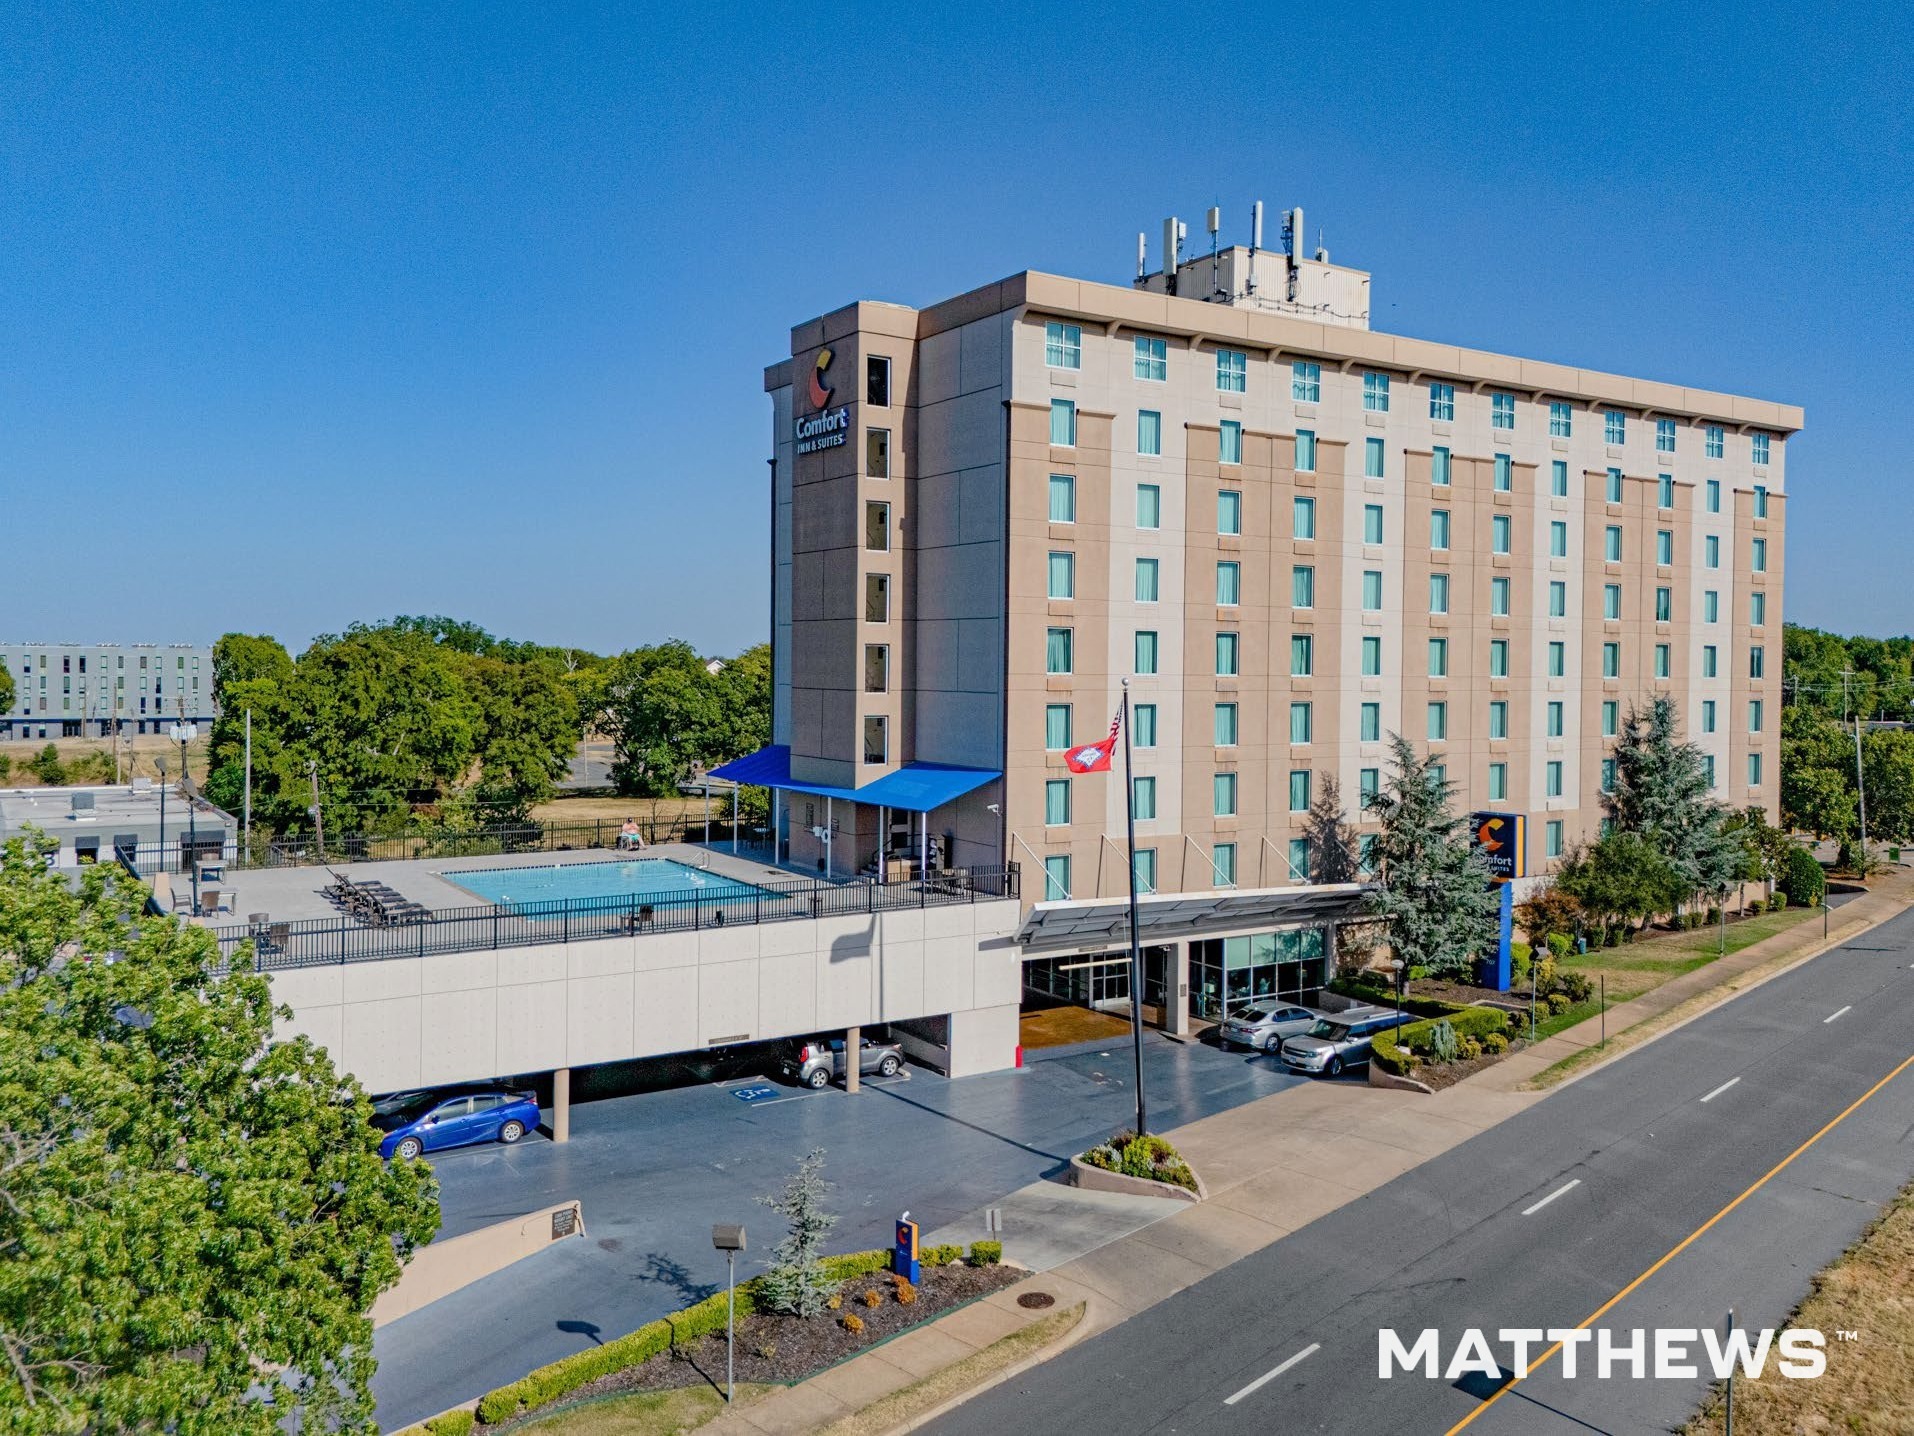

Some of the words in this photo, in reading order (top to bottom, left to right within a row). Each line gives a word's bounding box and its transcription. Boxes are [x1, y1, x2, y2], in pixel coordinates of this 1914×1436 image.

[796, 408, 846, 439] Comfort
[797, 442, 811, 454] INN
[811, 440, 817, 451] &
[817, 434, 843, 450] SUITES
[1478, 854, 1512, 867] omfort
